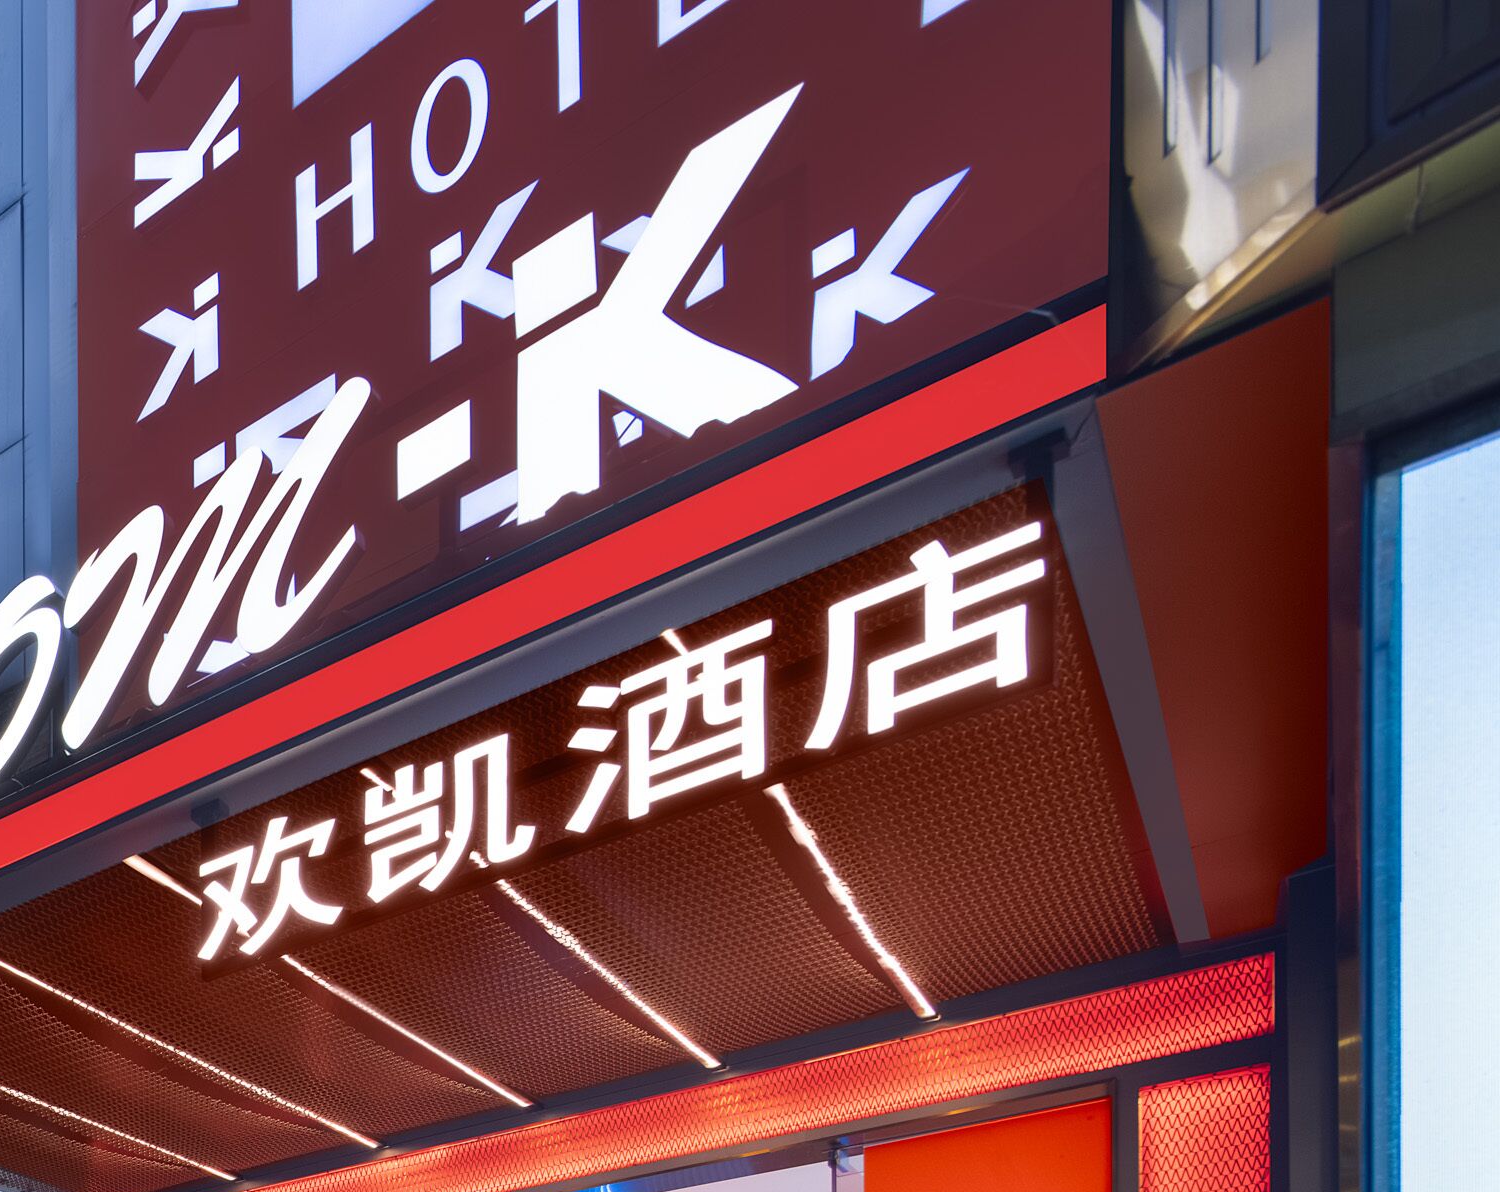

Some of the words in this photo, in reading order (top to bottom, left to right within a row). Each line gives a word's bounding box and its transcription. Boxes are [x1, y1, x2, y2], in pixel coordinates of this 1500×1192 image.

[296, 0, 734, 292] HOT
[197, 521, 1046, 963] 欢凯酒店
